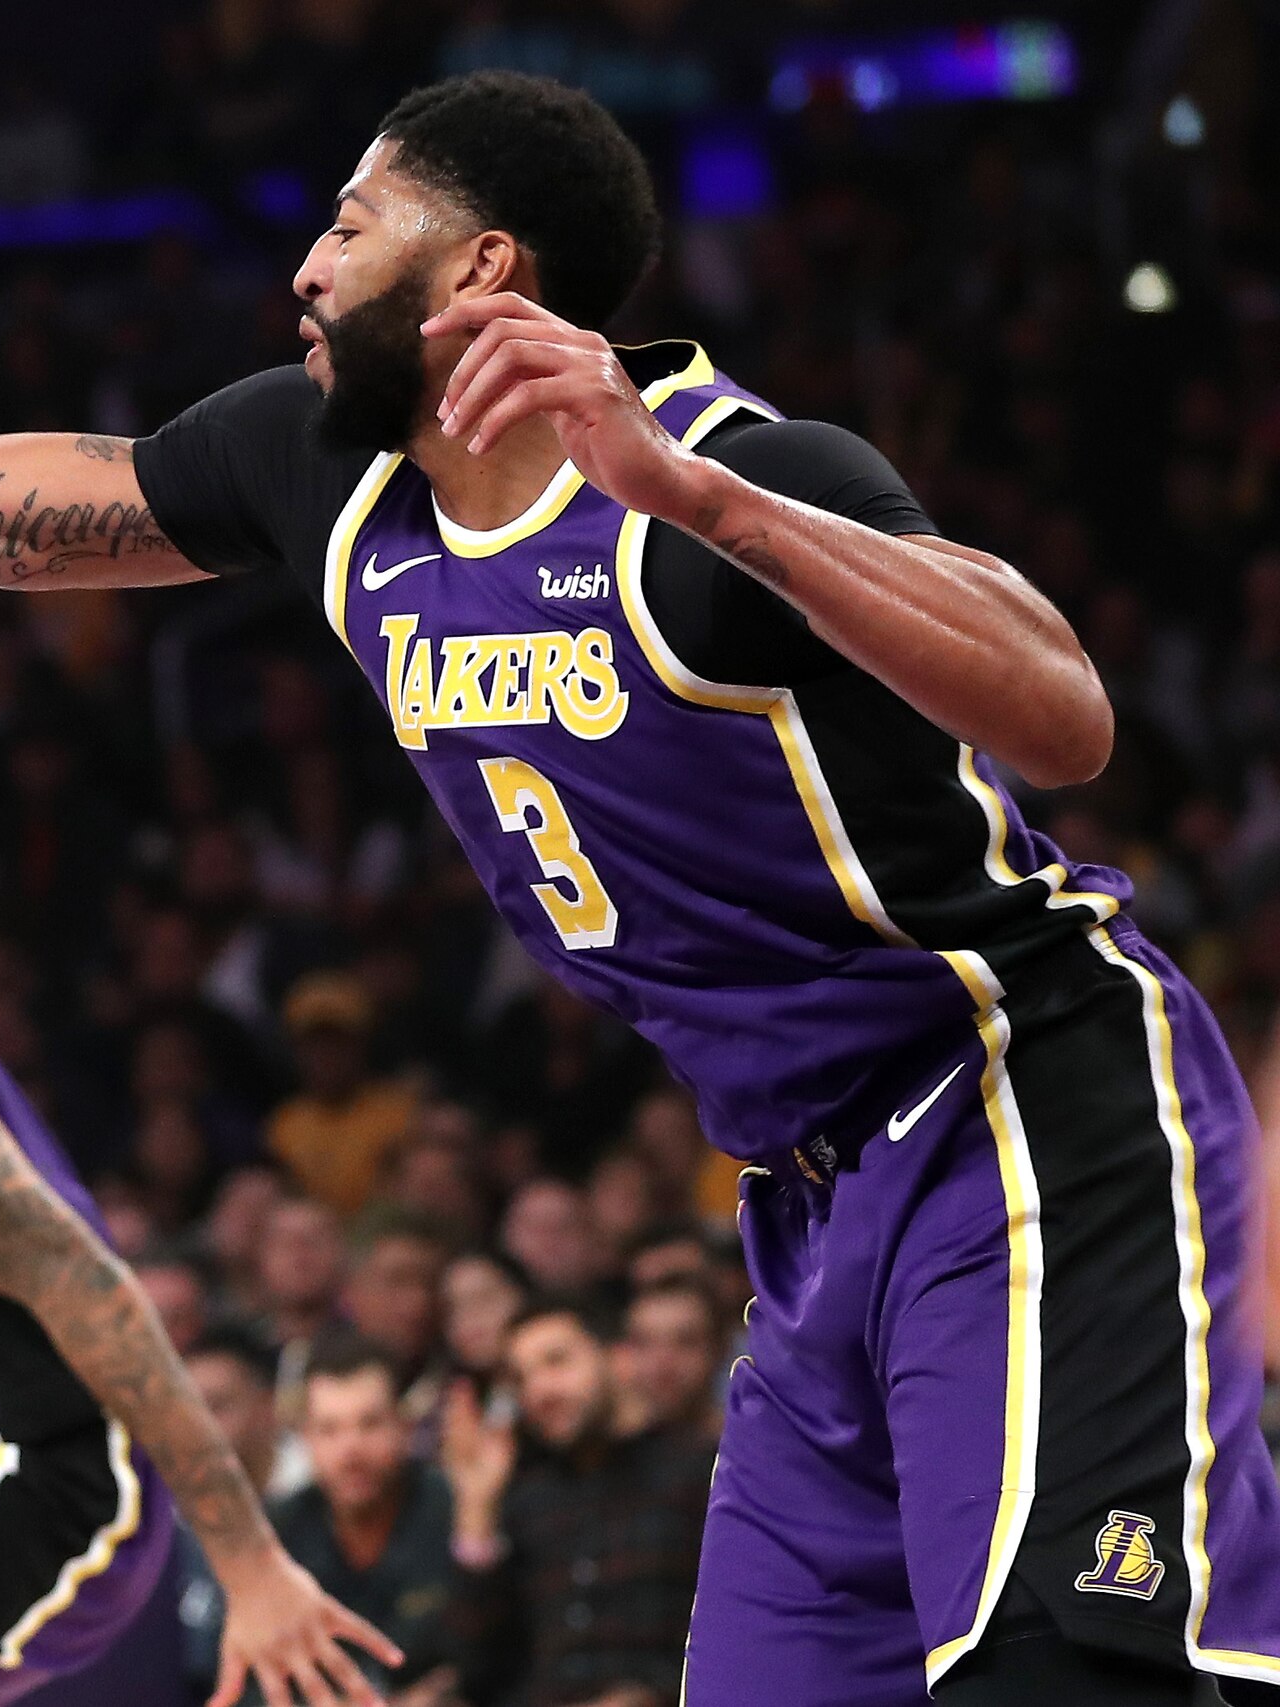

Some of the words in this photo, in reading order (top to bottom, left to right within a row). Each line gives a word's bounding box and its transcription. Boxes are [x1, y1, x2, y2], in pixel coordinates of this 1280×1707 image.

[537, 563, 610, 599] wish
[378, 612, 630, 751] LAKERS
[476, 756, 619, 951] 3
